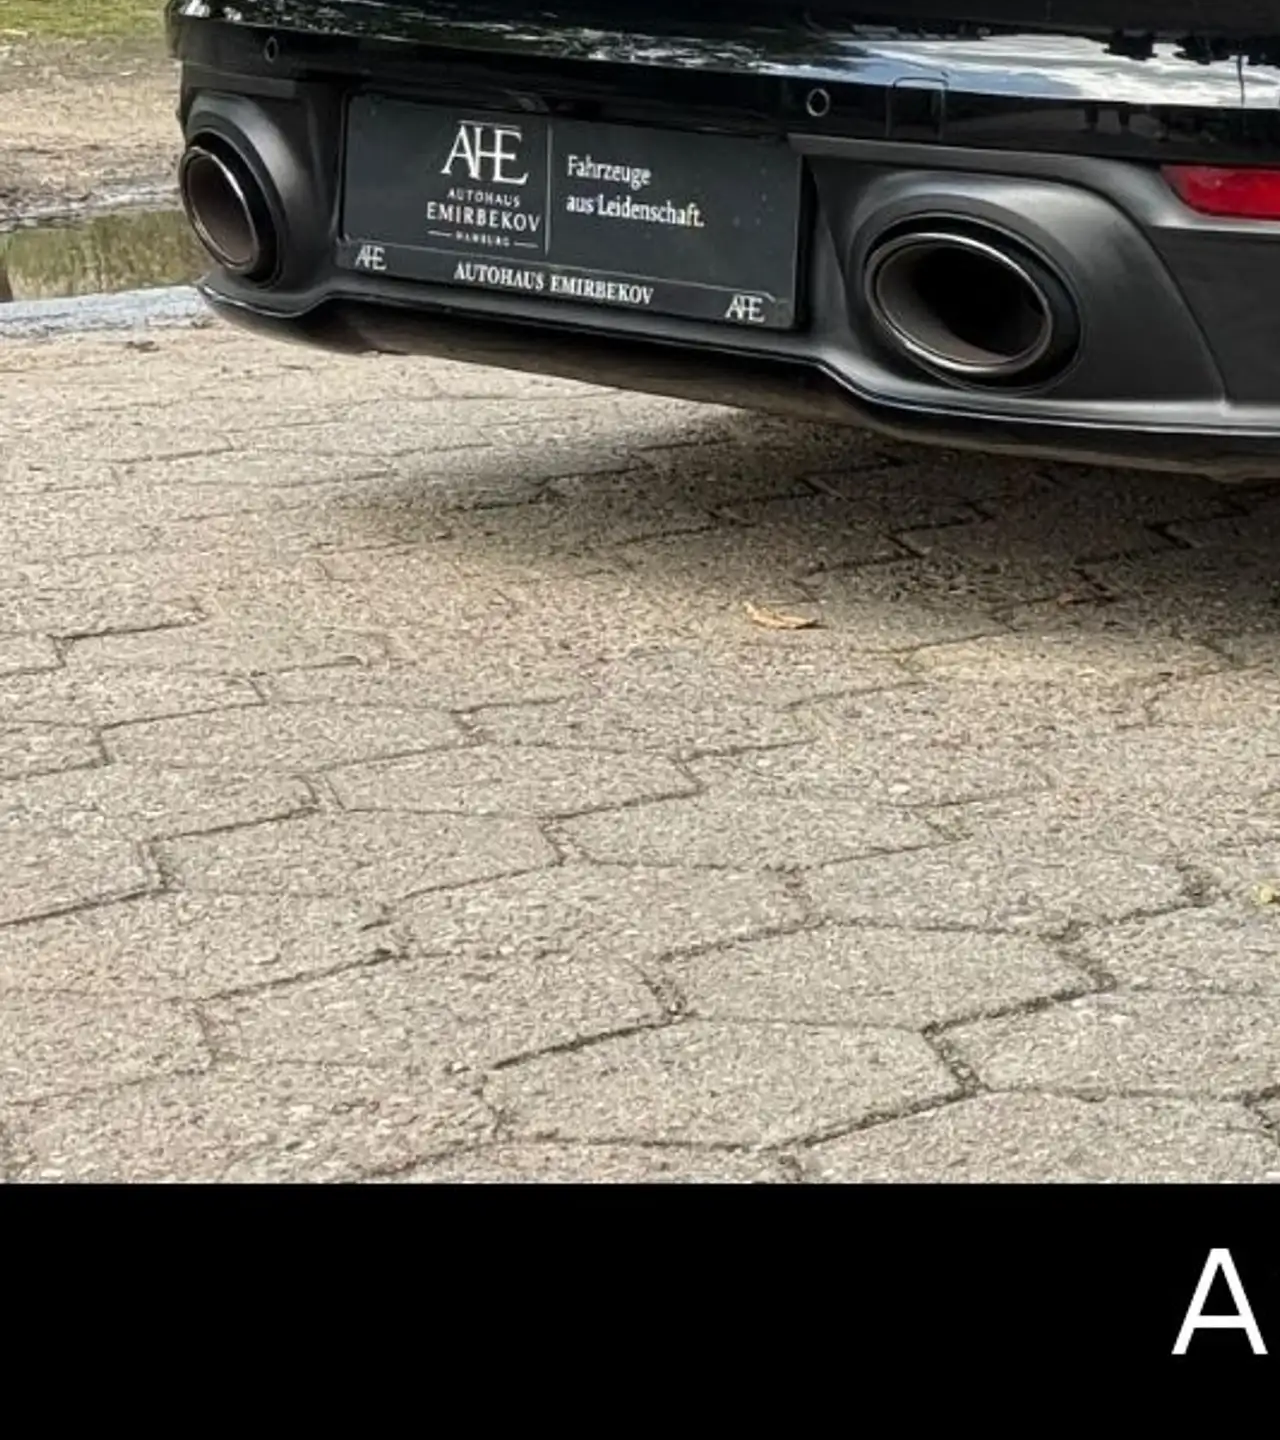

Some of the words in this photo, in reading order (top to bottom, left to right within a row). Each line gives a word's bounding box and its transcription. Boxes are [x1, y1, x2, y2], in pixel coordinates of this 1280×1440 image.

[440, 119, 529, 187] AHE
[567, 155, 652, 188] Fahrzeuge
[447, 187, 522, 209] AUTOHAUS
[566, 193, 595, 214] aus
[598, 195, 705, 228] Leidenschaft.
[426, 200, 541, 233] EMIRBEKOV
[355, 245, 388, 272] AHE
[453, 261, 545, 292] AUTOHAUS
[550, 274, 655, 306] EMIRBEKOV
[724, 293, 766, 324] AHE
